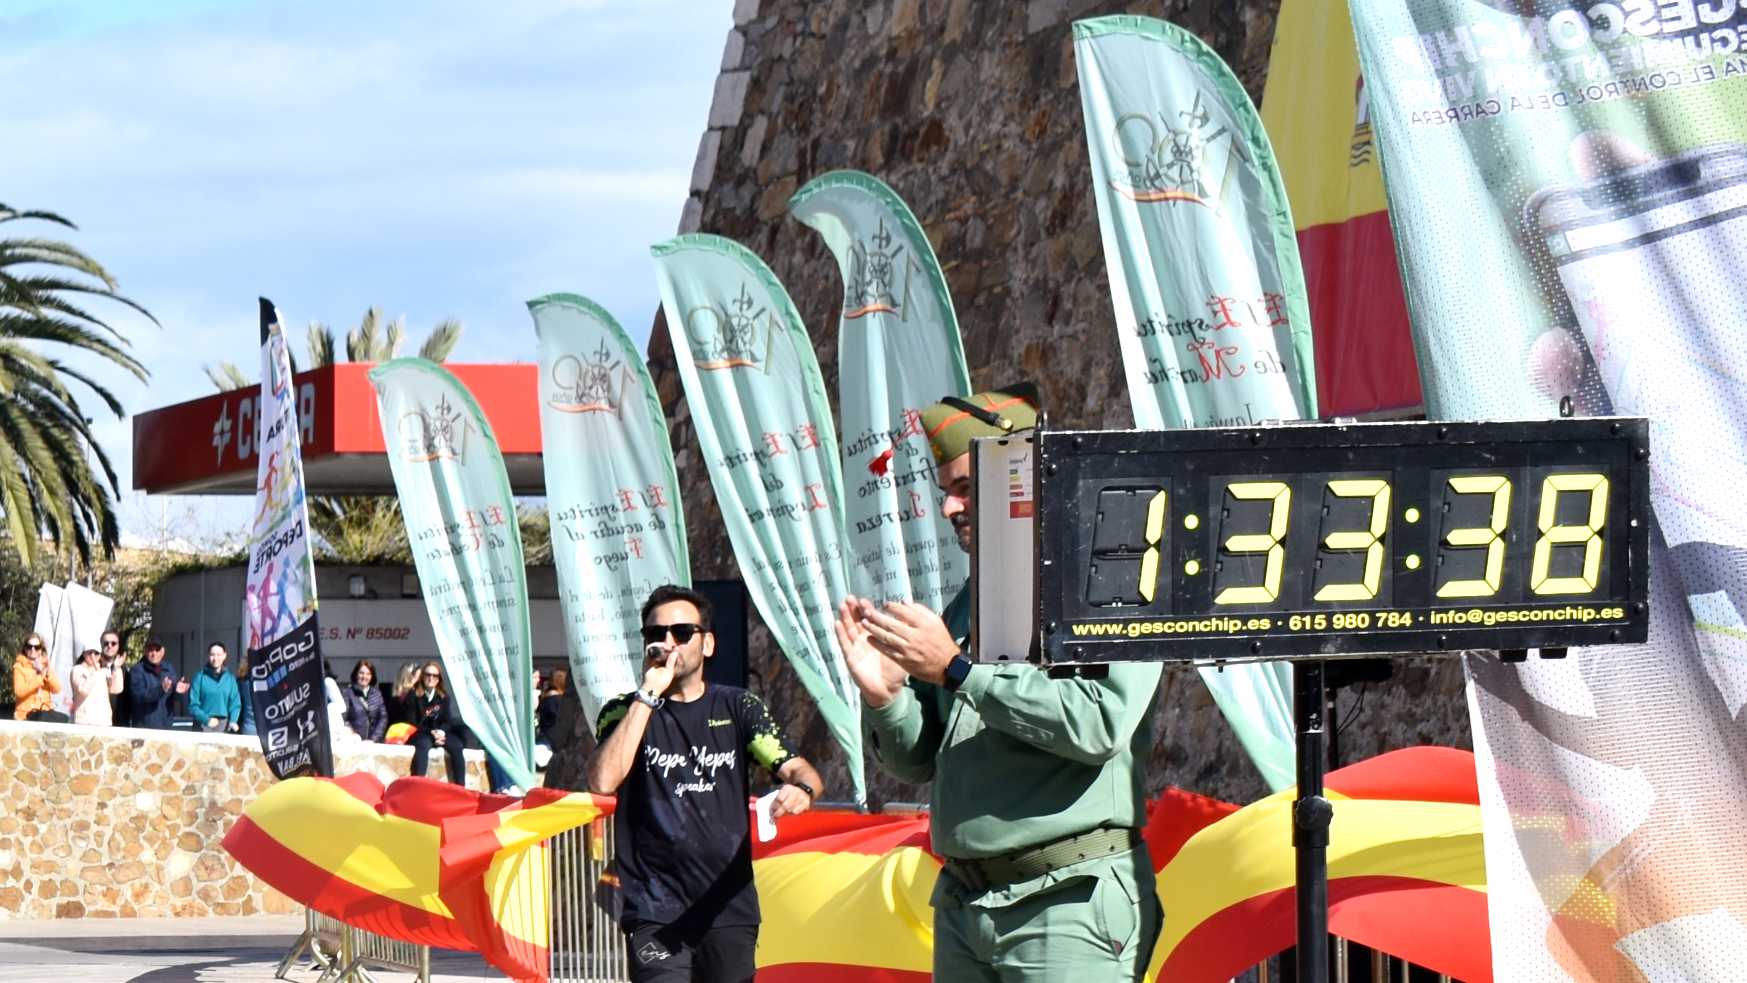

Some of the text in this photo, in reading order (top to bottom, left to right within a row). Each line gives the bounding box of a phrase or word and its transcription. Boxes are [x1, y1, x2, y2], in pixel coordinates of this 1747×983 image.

[1138, 473, 1610, 604] 1:33:38
[365, 627, 410, 640] 85002
[1072, 605, 1623, 637] www.gesconchip.es 615 980 784 info@gesconchip.es
[644, 744, 688, 778] Pepe
[674, 778, 717, 798] speaker
